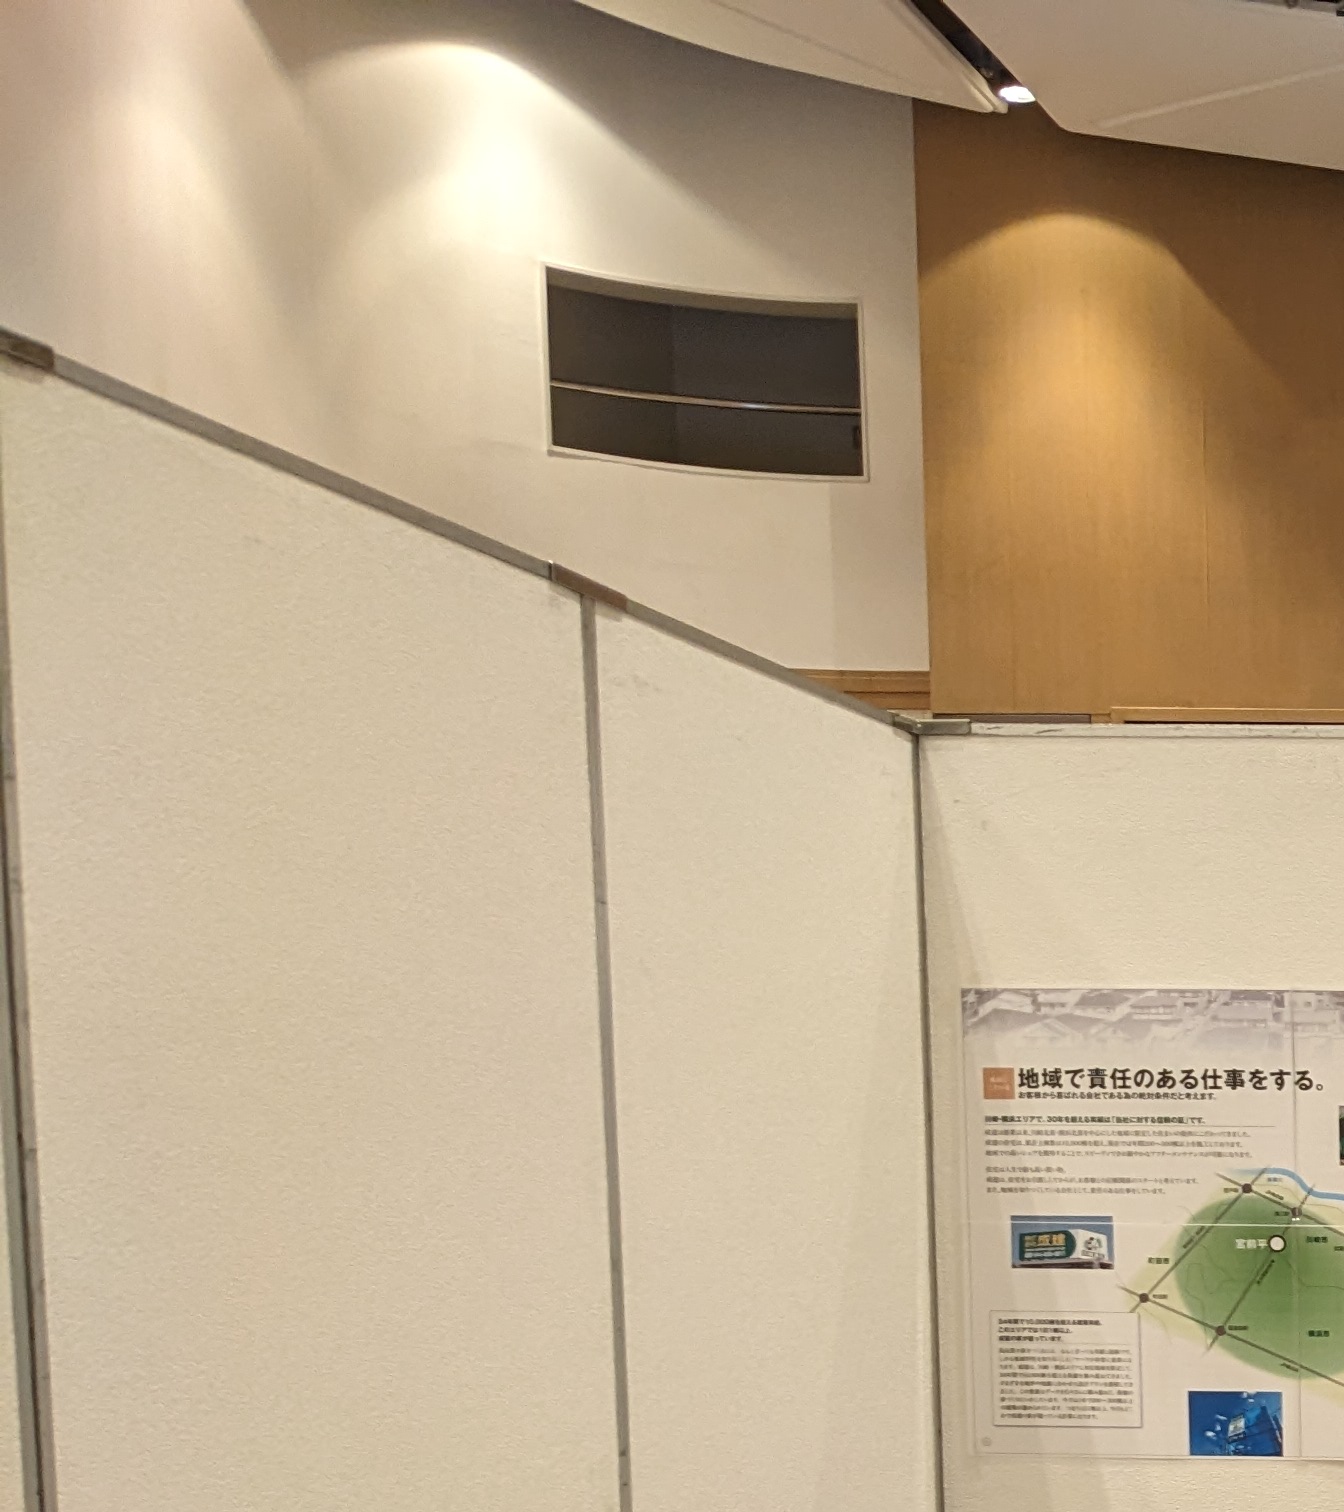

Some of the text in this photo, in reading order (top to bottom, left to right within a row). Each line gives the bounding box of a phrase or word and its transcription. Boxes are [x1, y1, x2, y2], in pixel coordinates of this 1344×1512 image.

[1018, 1067, 1324, 1091] 地域で責任のある仕事をする。
